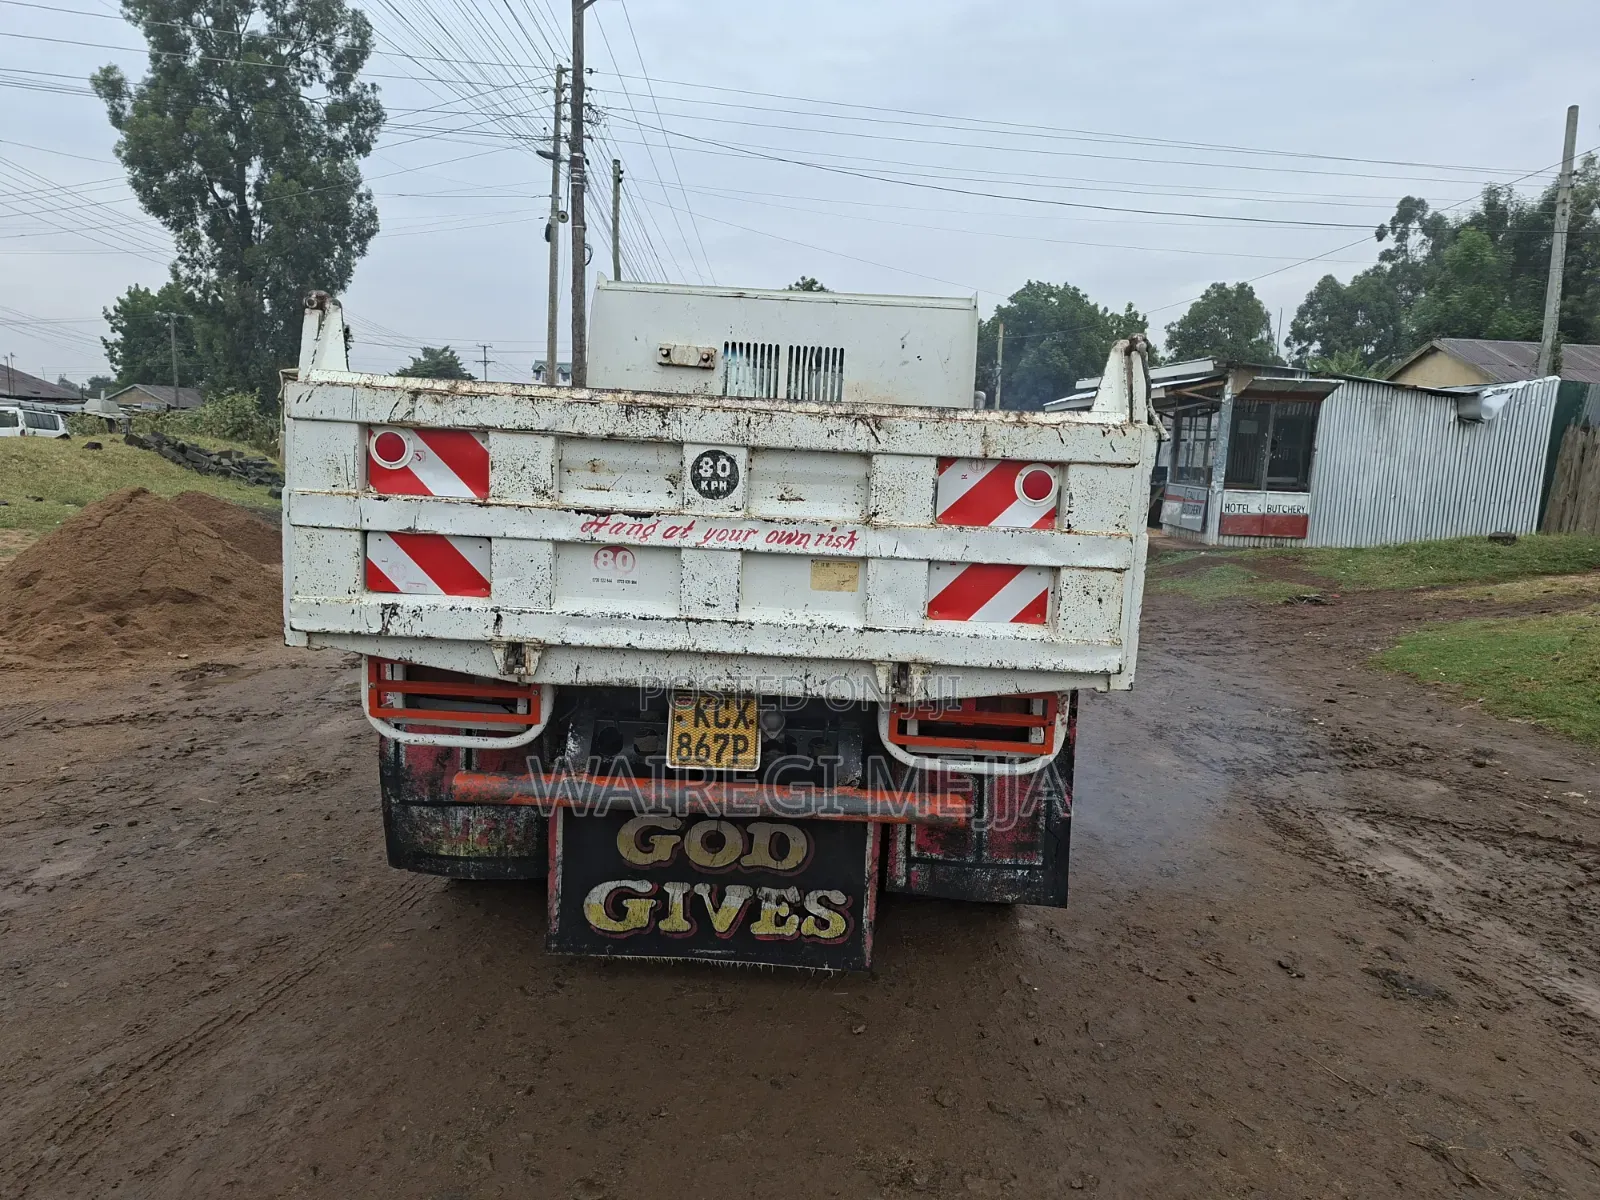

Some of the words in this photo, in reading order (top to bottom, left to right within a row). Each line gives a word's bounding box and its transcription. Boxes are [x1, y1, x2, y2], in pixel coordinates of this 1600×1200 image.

[698, 455, 731, 478] 80
[700, 480, 728, 491] KPH
[1224, 503, 1251, 514] HOTEL
[1266, 504, 1306, 514] BUTCHERY
[580, 515, 662, 543] Hang
[663, 519, 696, 539] at
[695, 527, 758, 546] your
[596, 549, 634, 573] 80
[694, 696, 750, 730] KCX
[677, 732, 749, 765] 867P
[616, 814, 811, 873] GOD
[583, 879, 850, 941] GIVES
